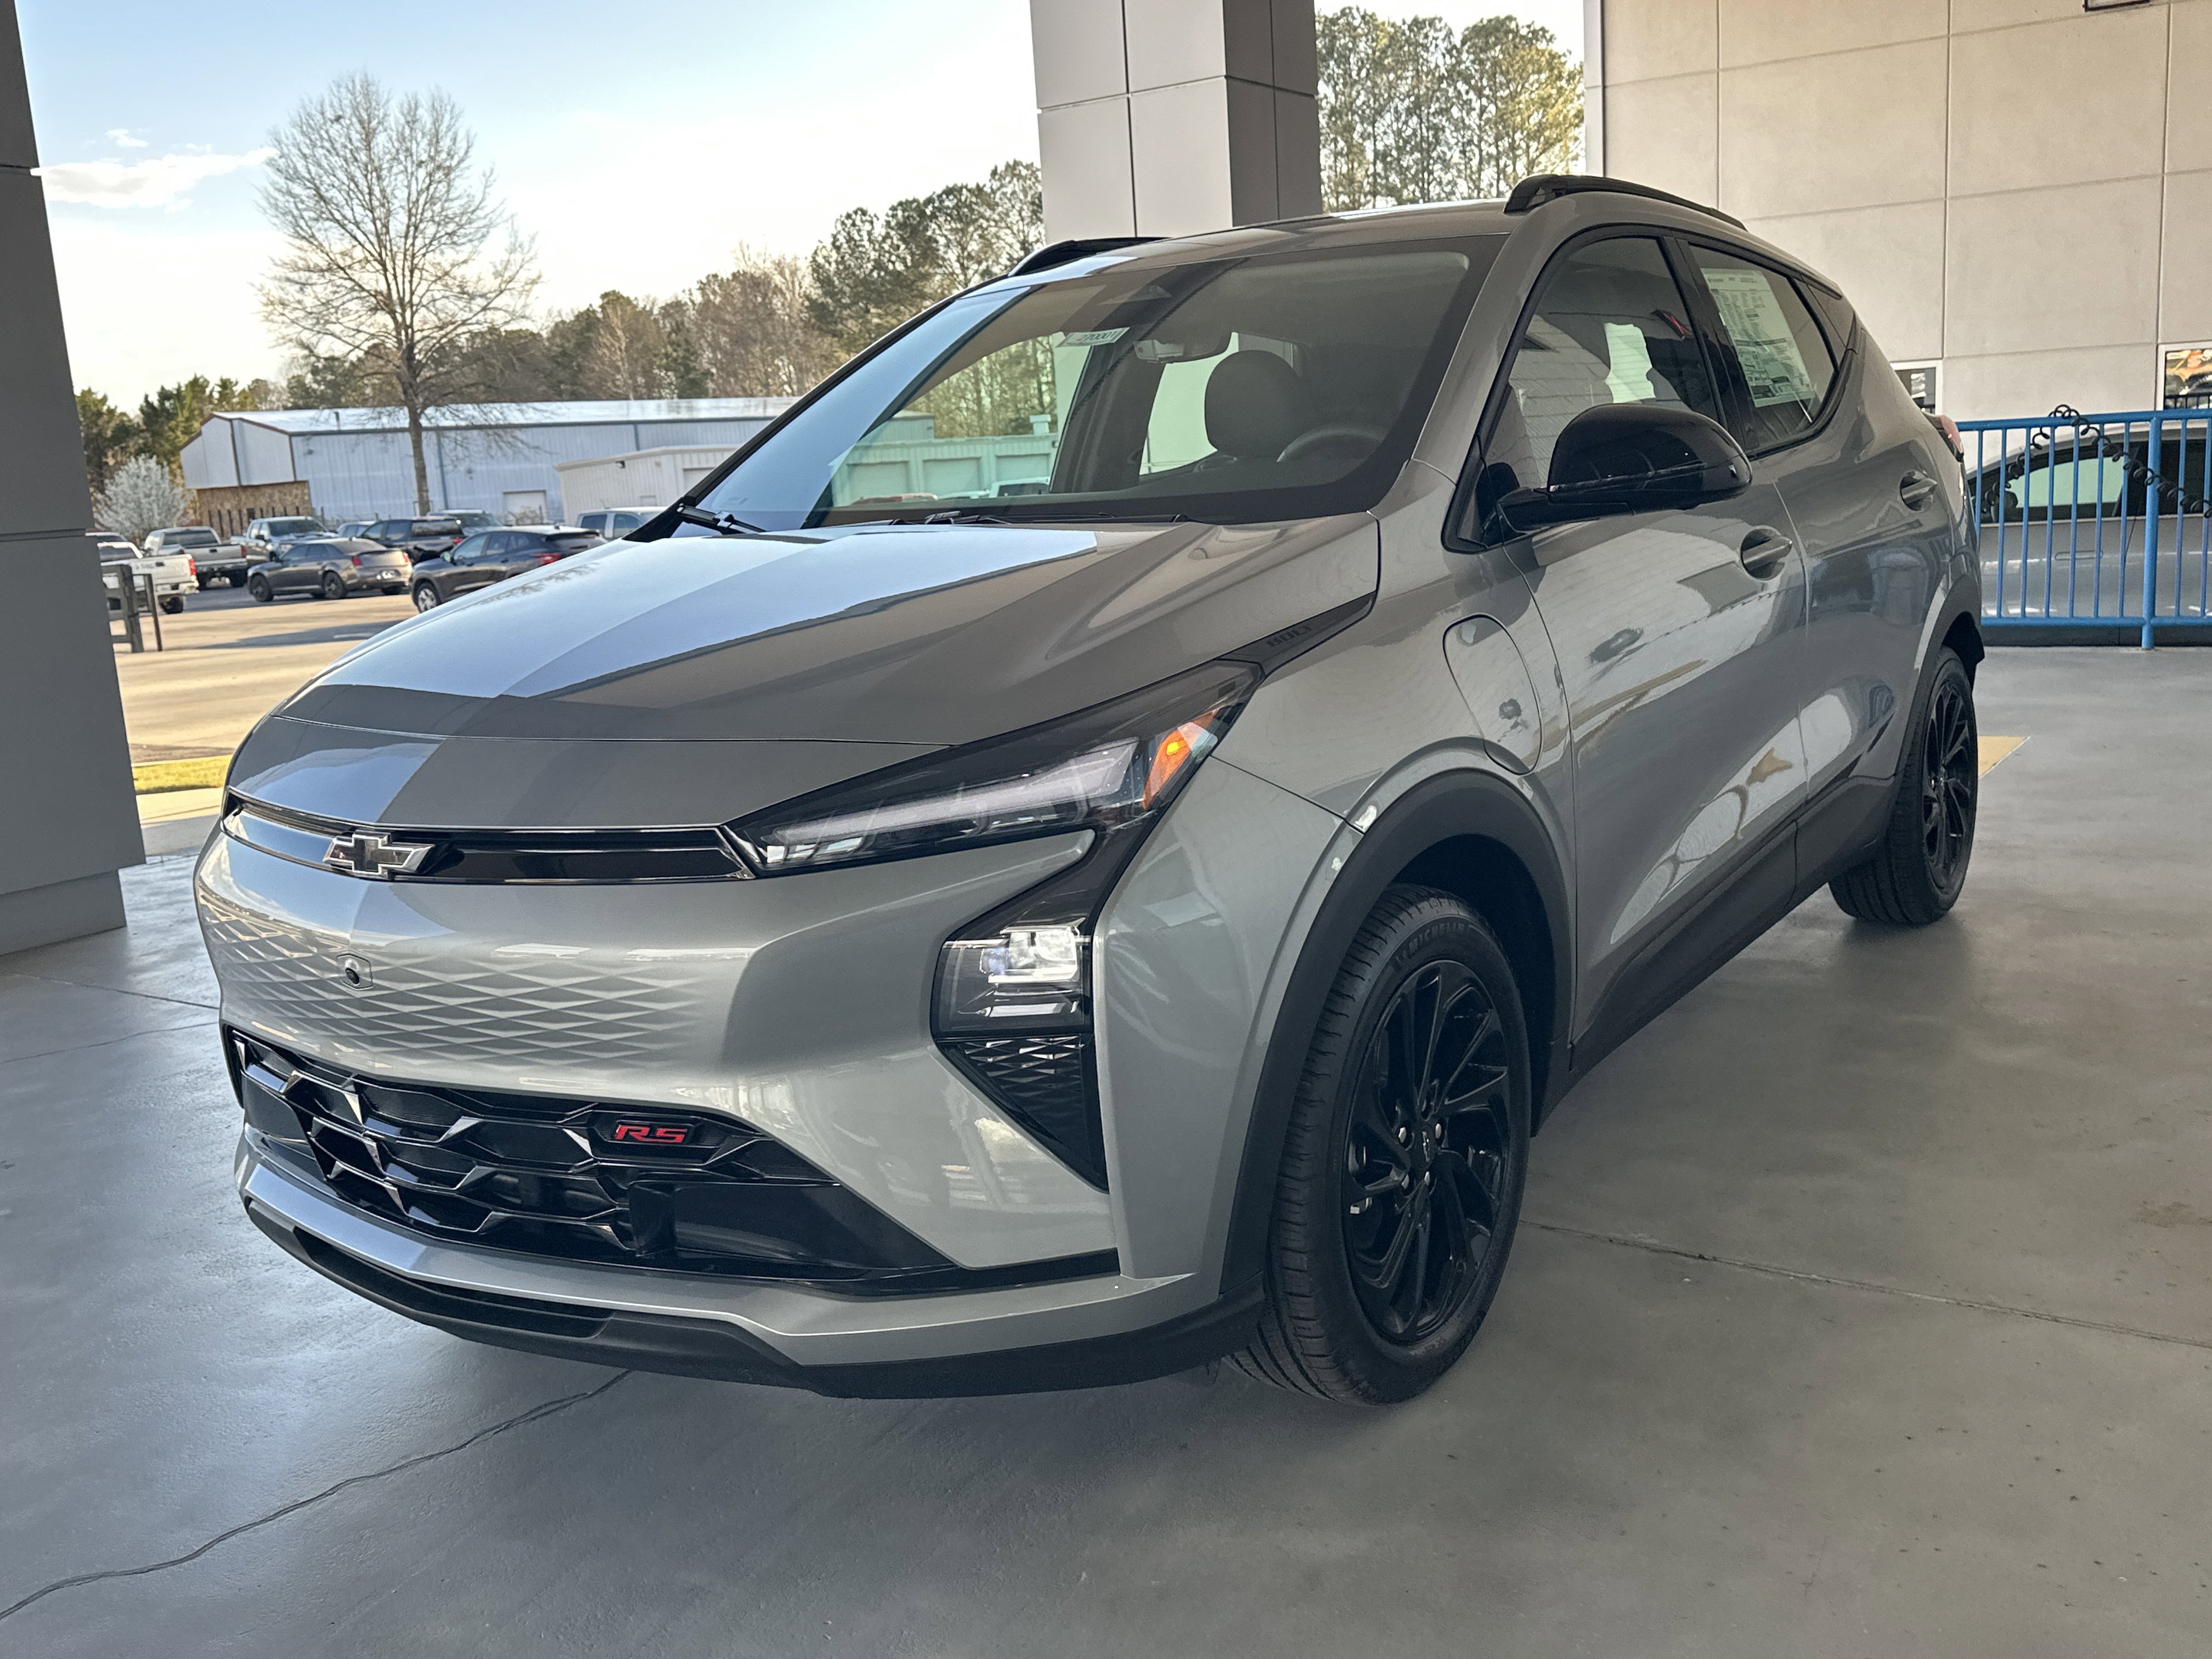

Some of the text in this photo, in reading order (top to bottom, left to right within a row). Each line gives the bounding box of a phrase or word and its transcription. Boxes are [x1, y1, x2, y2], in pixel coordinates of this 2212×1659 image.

[1077, 331, 1118, 341] 270001
[1266, 624, 1312, 647] BOLT
[1408, 922, 1465, 953] MICHELIN
[614, 1124, 687, 1143] RS
